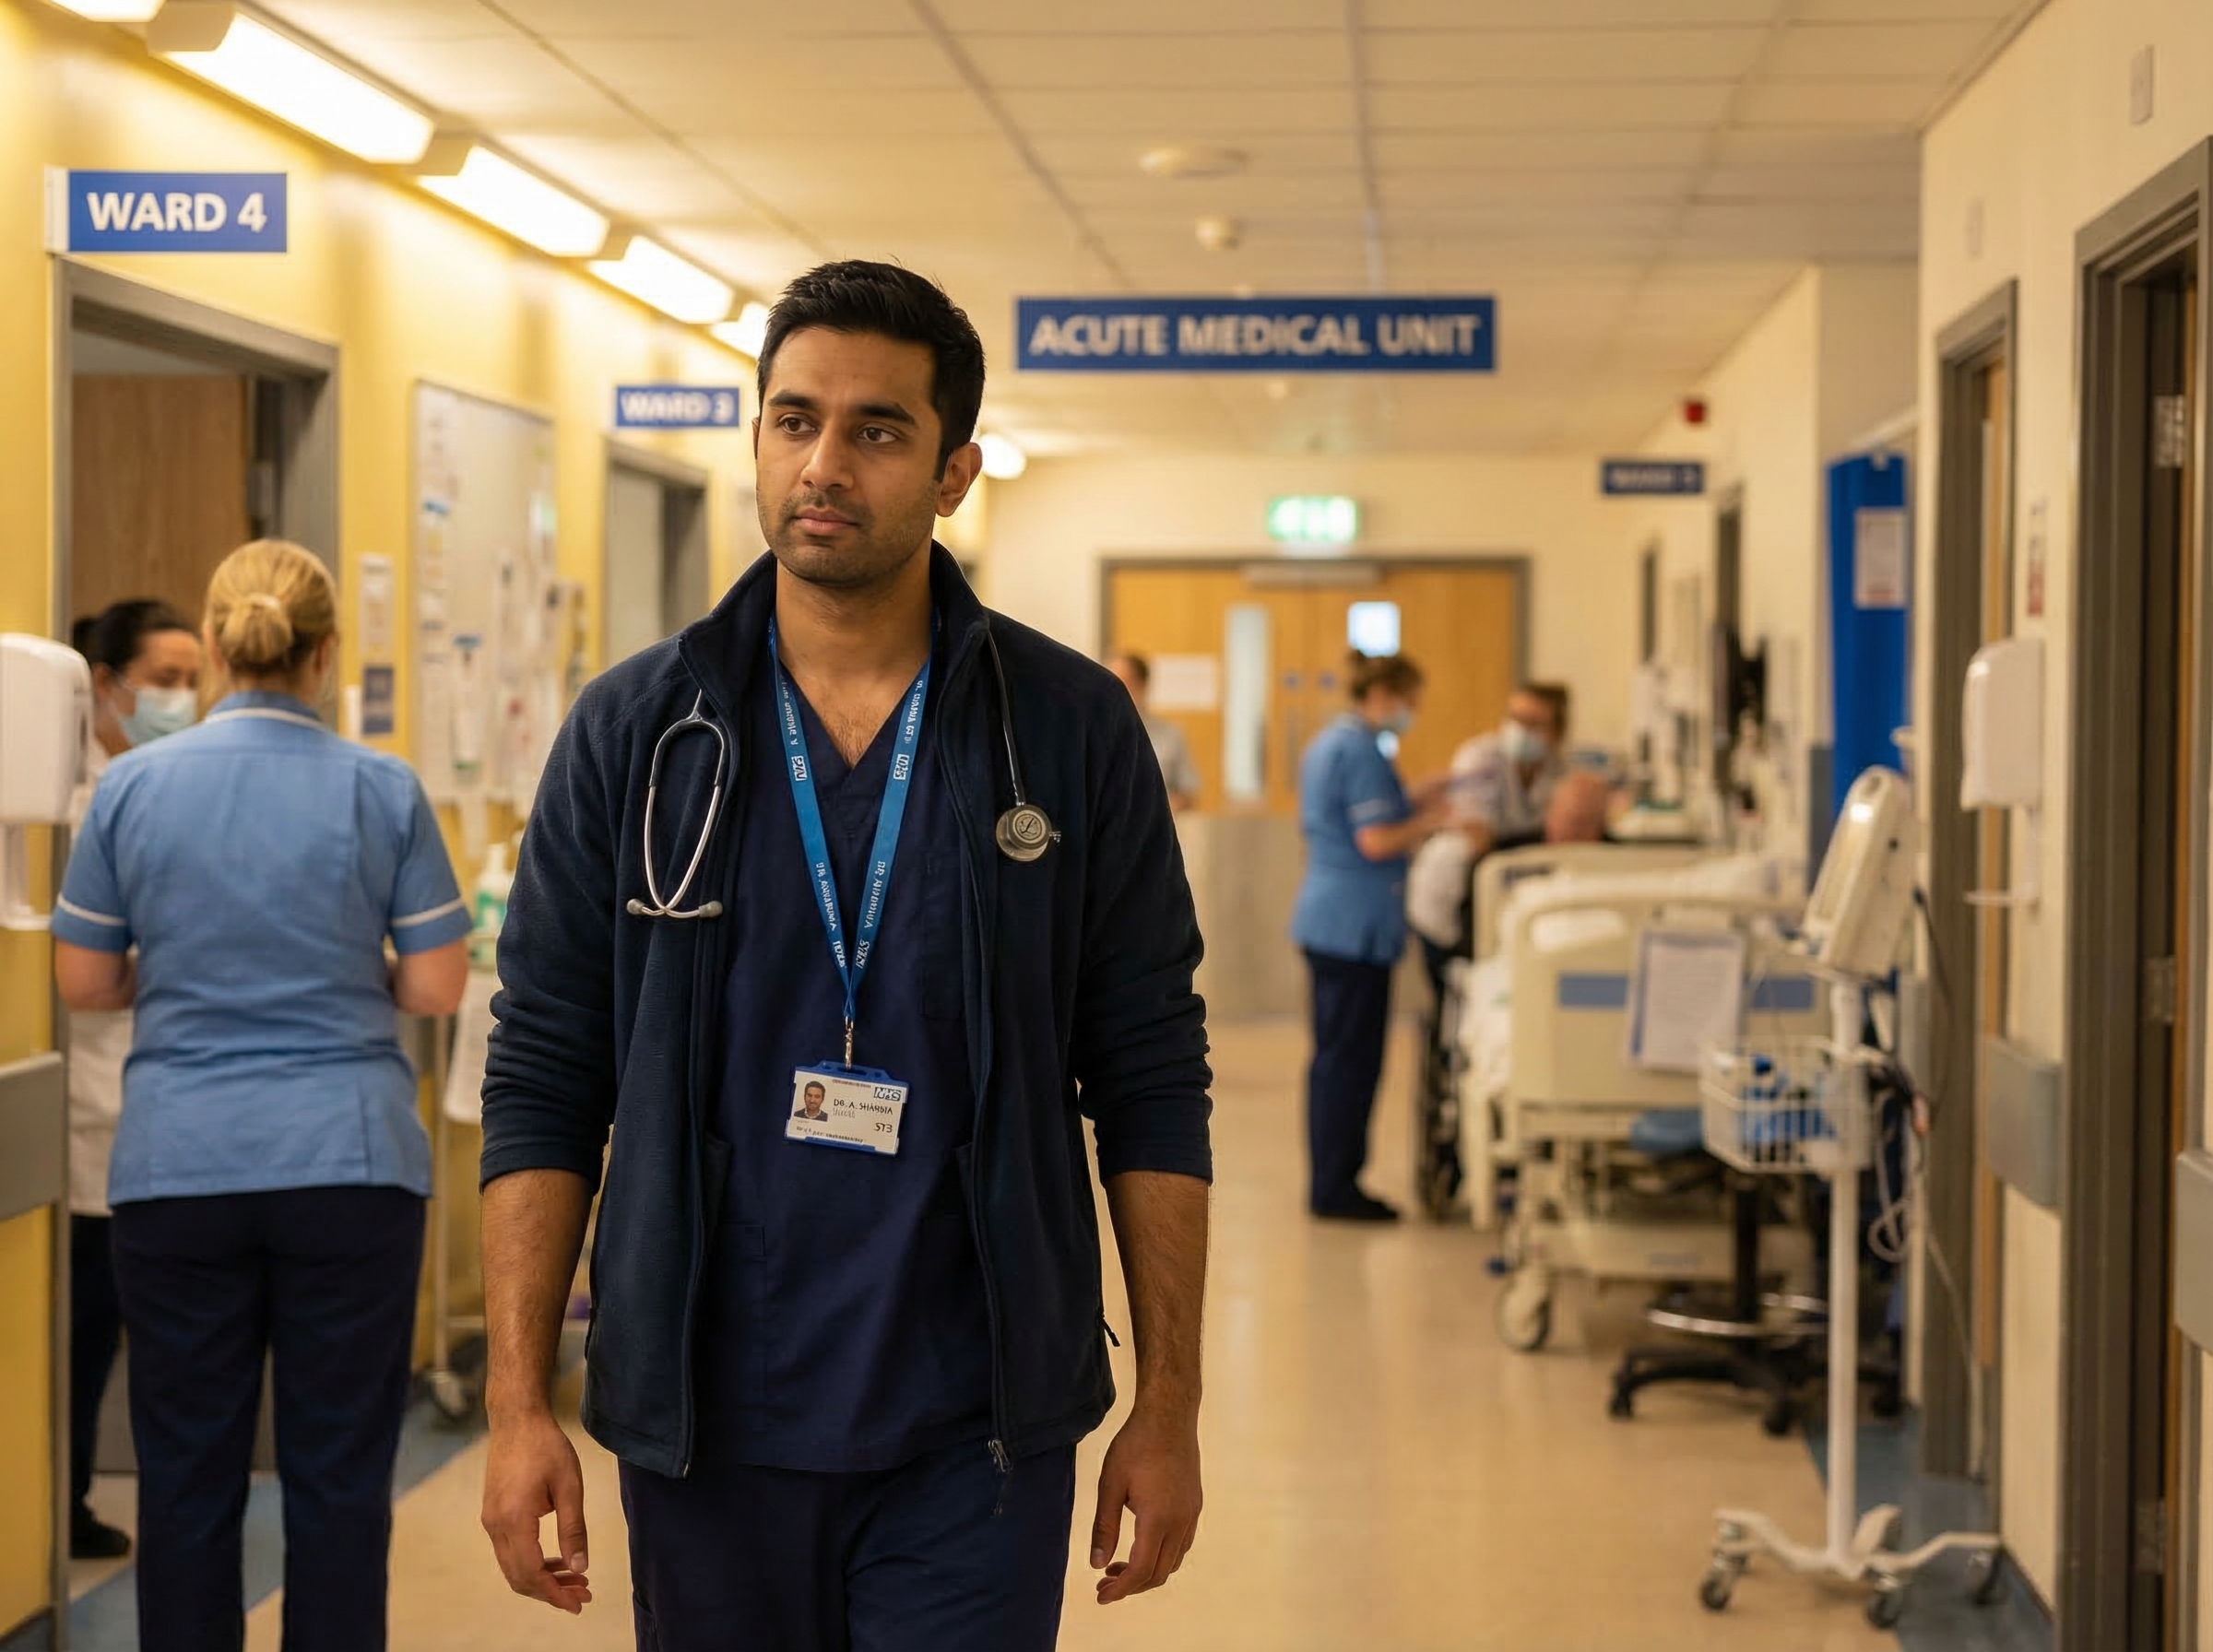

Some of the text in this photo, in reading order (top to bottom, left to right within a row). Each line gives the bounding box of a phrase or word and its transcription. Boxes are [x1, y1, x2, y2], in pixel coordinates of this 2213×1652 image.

[87, 192, 267, 233] WARD 4
[1028, 313, 1481, 356] ACUTE MEDICAL UNIT
[620, 391, 711, 422] WARD
